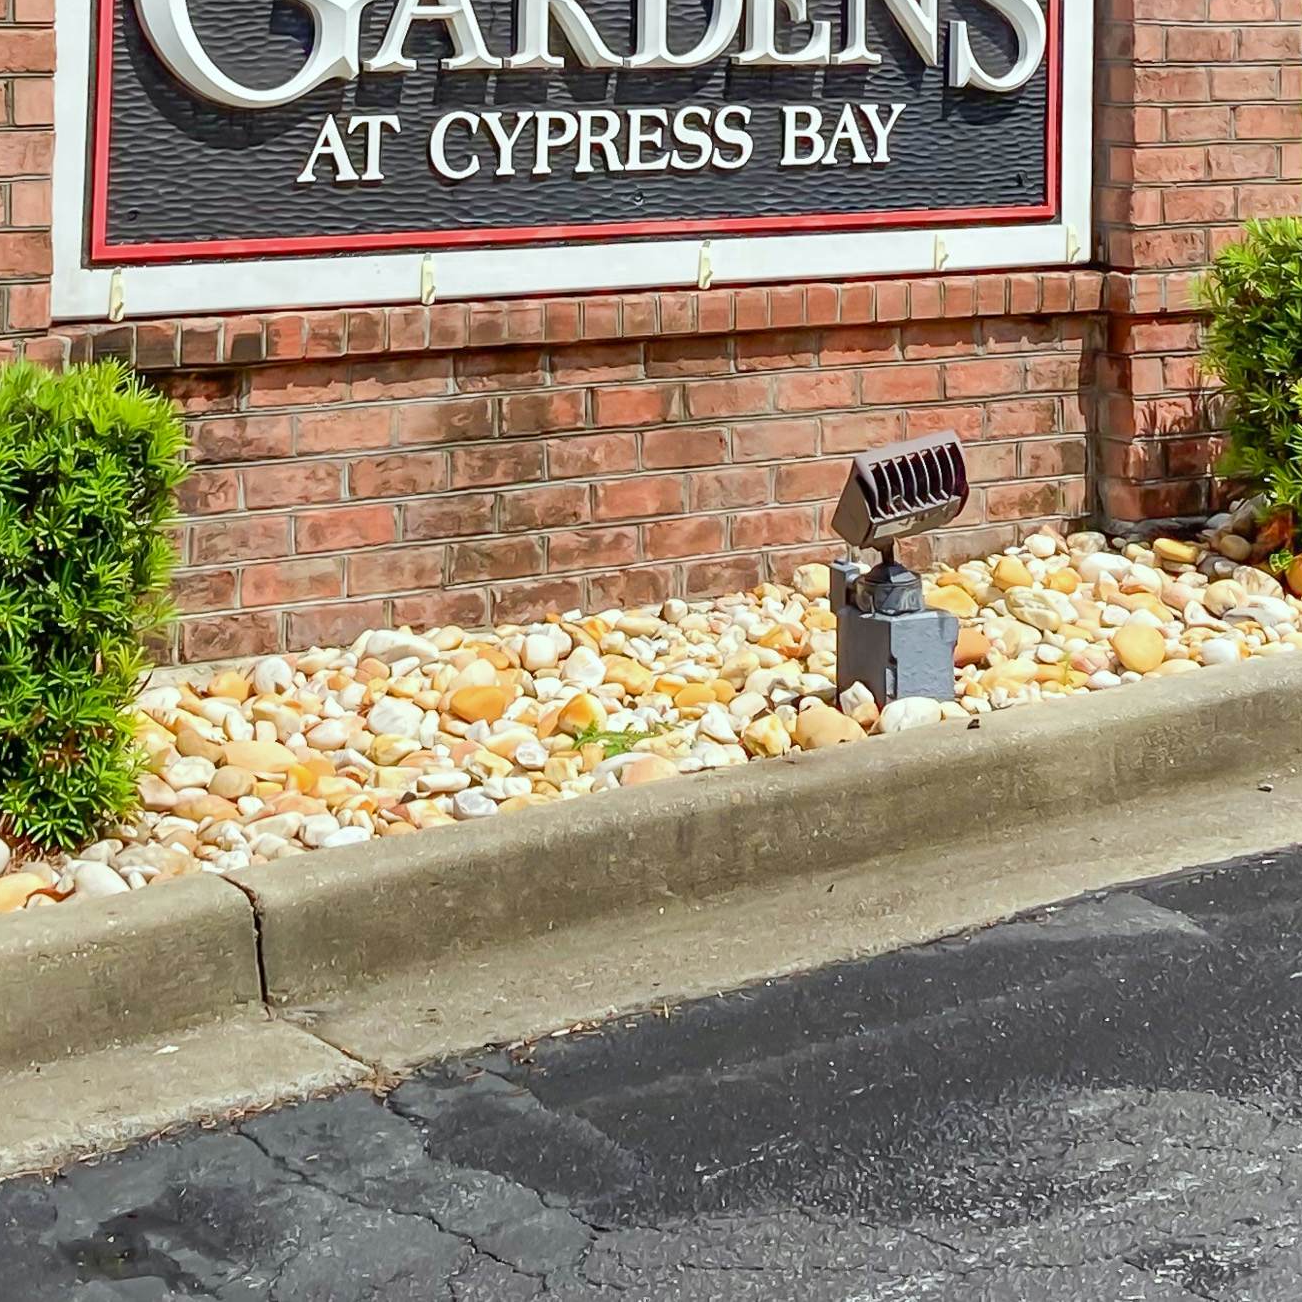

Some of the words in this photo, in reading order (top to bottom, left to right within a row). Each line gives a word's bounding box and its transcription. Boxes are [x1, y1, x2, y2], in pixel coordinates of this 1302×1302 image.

[296, 113, 400, 183] AT
[428, 105, 752, 181] CYPRESS
[780, 103, 906, 166] BAY
